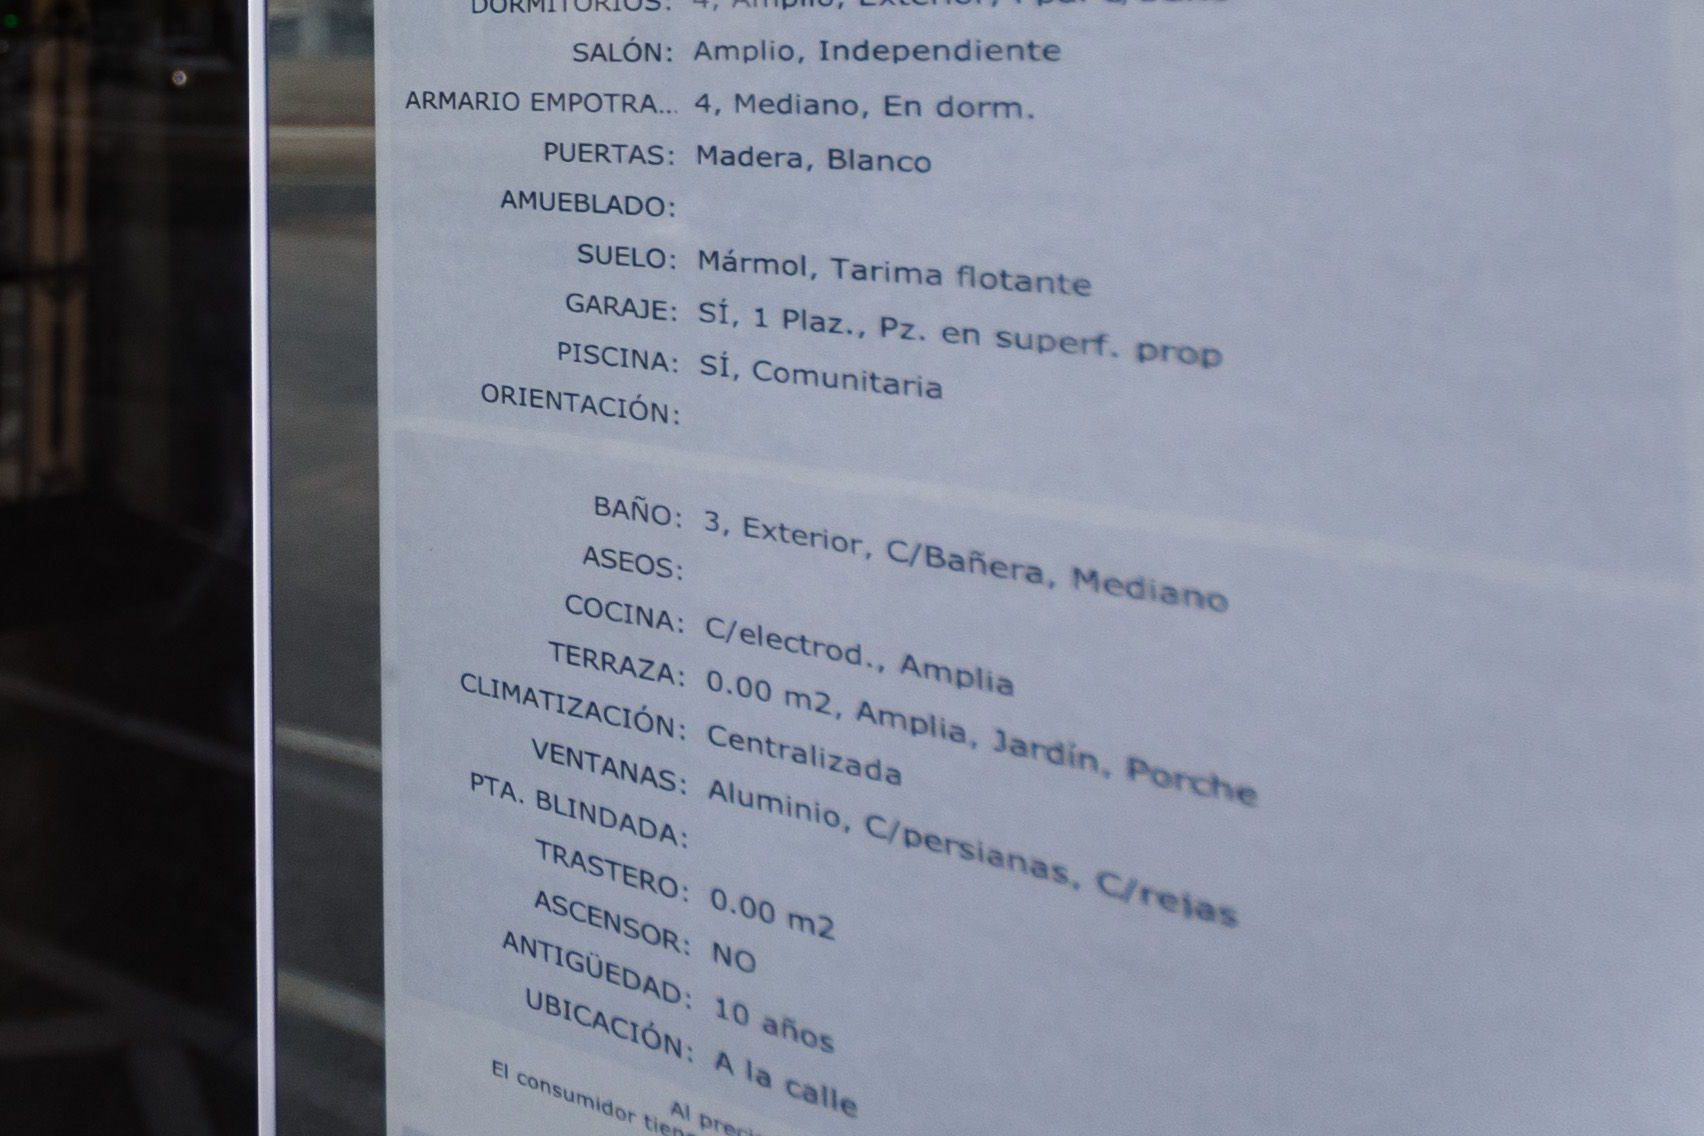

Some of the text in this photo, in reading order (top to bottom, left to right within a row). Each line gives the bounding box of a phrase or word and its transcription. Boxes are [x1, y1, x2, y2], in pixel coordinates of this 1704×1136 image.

[572, 36, 1061, 65] SALÓN: Amplio, Independiente
[404, 90, 1035, 120] ARMARIO EMPOTRA... 4, Mediano, En dorm.
[544, 141, 932, 174] PUERTAS: Madera, Blanco
[500, 189, 675, 218] AMUEBLADO:
[577, 243, 1092, 298] SUELO: Mármol, Tarima flotante
[565, 292, 1223, 370] GARAJE: SÍ, 1 Plaz., Pz. en superf. prop
[480, 382, 680, 426] ORIENTACIÓN:
[557, 341, 943, 400] PISCINA: SÍ, Comunitaria
[582, 545, 683, 581] ASEOS:
[594, 495, 1229, 613] BAÑO: 3, Exterior, C/Bañera, Mediano
[564, 593, 1015, 697] COCINA: C/electrod., Amplia
[460, 672, 902, 787] CLIMATIZACIÓN: Centralizada
[547, 640, 1258, 808] TERRAZA: 0.00 m2, Amplia, Jardín, Porche
[470, 771, 687, 849] PTA. BLINDADA:
[531, 738, 1239, 929] VENTANAS: Aluminio, C/persianas, C/rejas
[534, 838, 835, 941] TRASTERO: 0.00 m2
[534, 889, 757, 974] ASCENSOR: NO
[502, 930, 835, 1054] ANTIGÜEDAD: 10 años
[491, 1059, 509, 1080] El
[516, 1072, 637, 1123] consumidor
[525, 987, 858, 1119] UBICACIÓN: A la calle
[670, 1100, 691, 1121] Al
